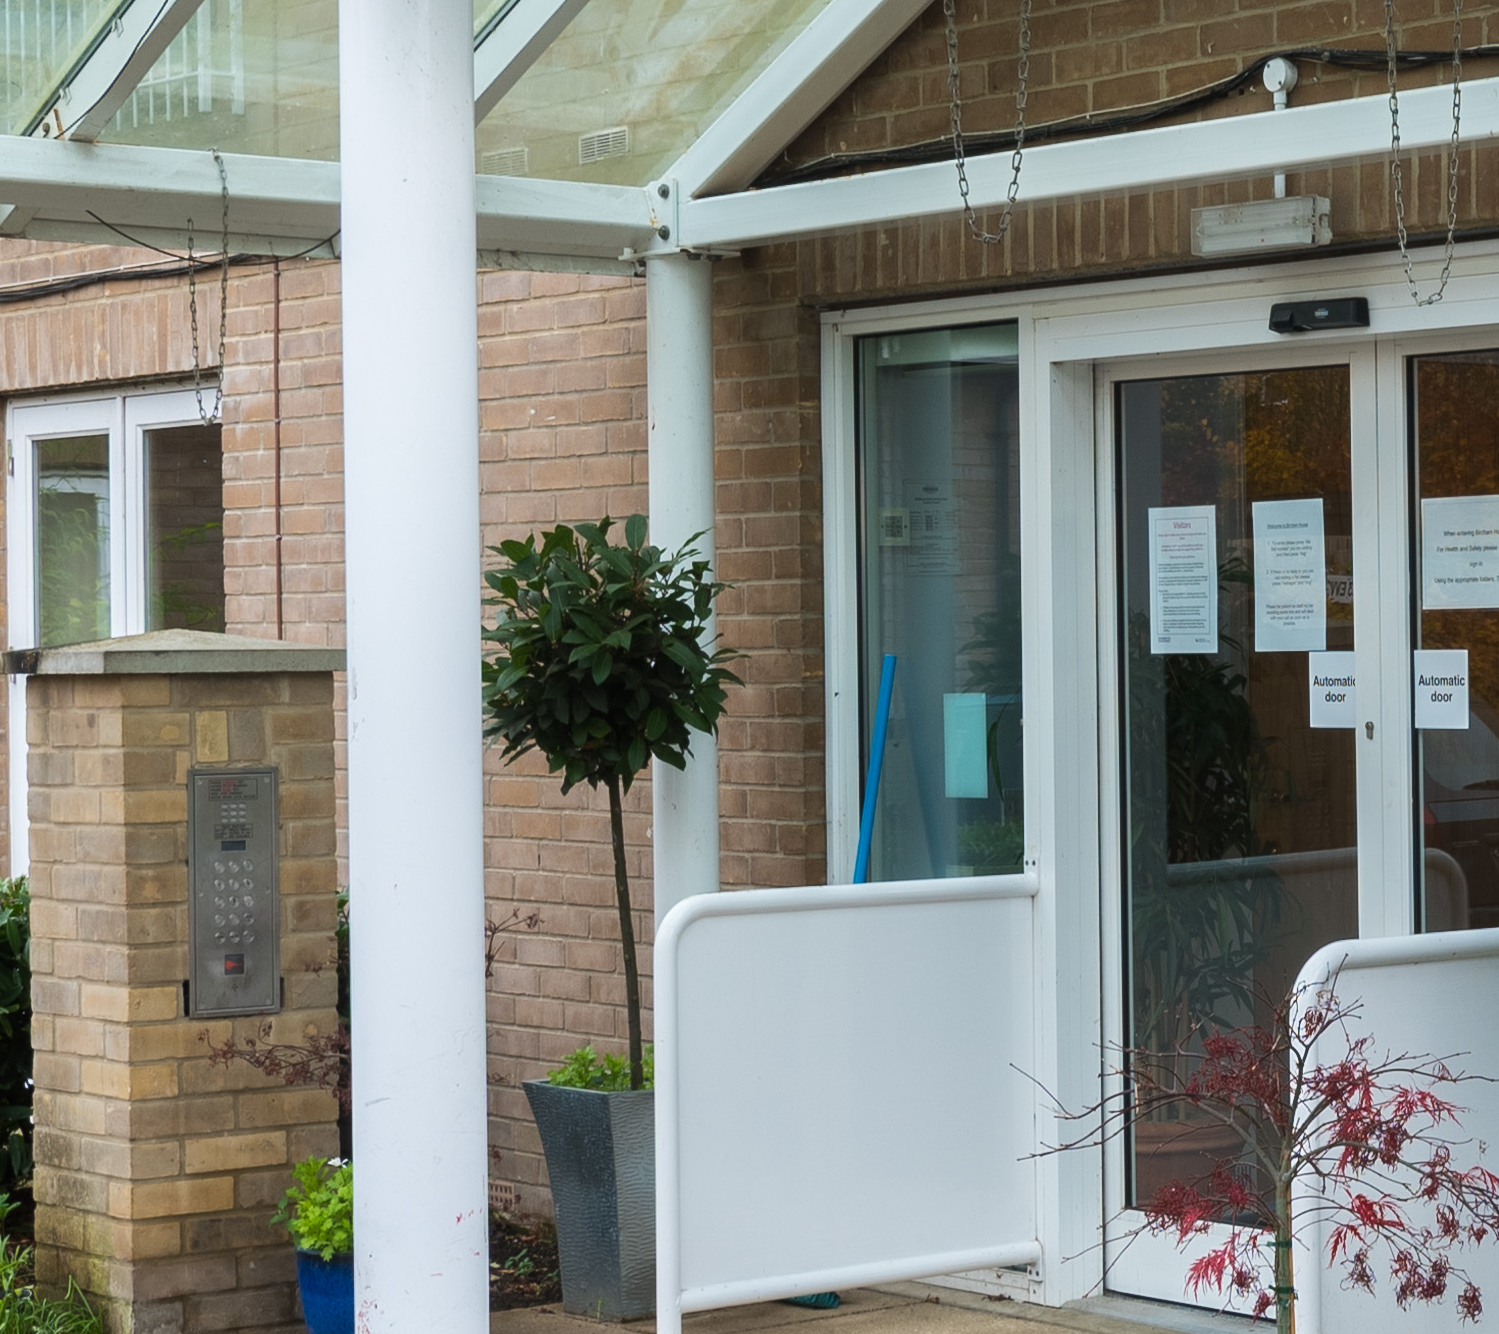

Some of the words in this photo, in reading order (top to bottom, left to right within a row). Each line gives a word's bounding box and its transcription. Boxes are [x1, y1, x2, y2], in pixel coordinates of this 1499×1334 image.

[1313, 675, 1356, 687] Automatic
[1418, 674, 1465, 686] Automatic
[1325, 691, 1346, 702] door
[1431, 691, 1453, 702] door
